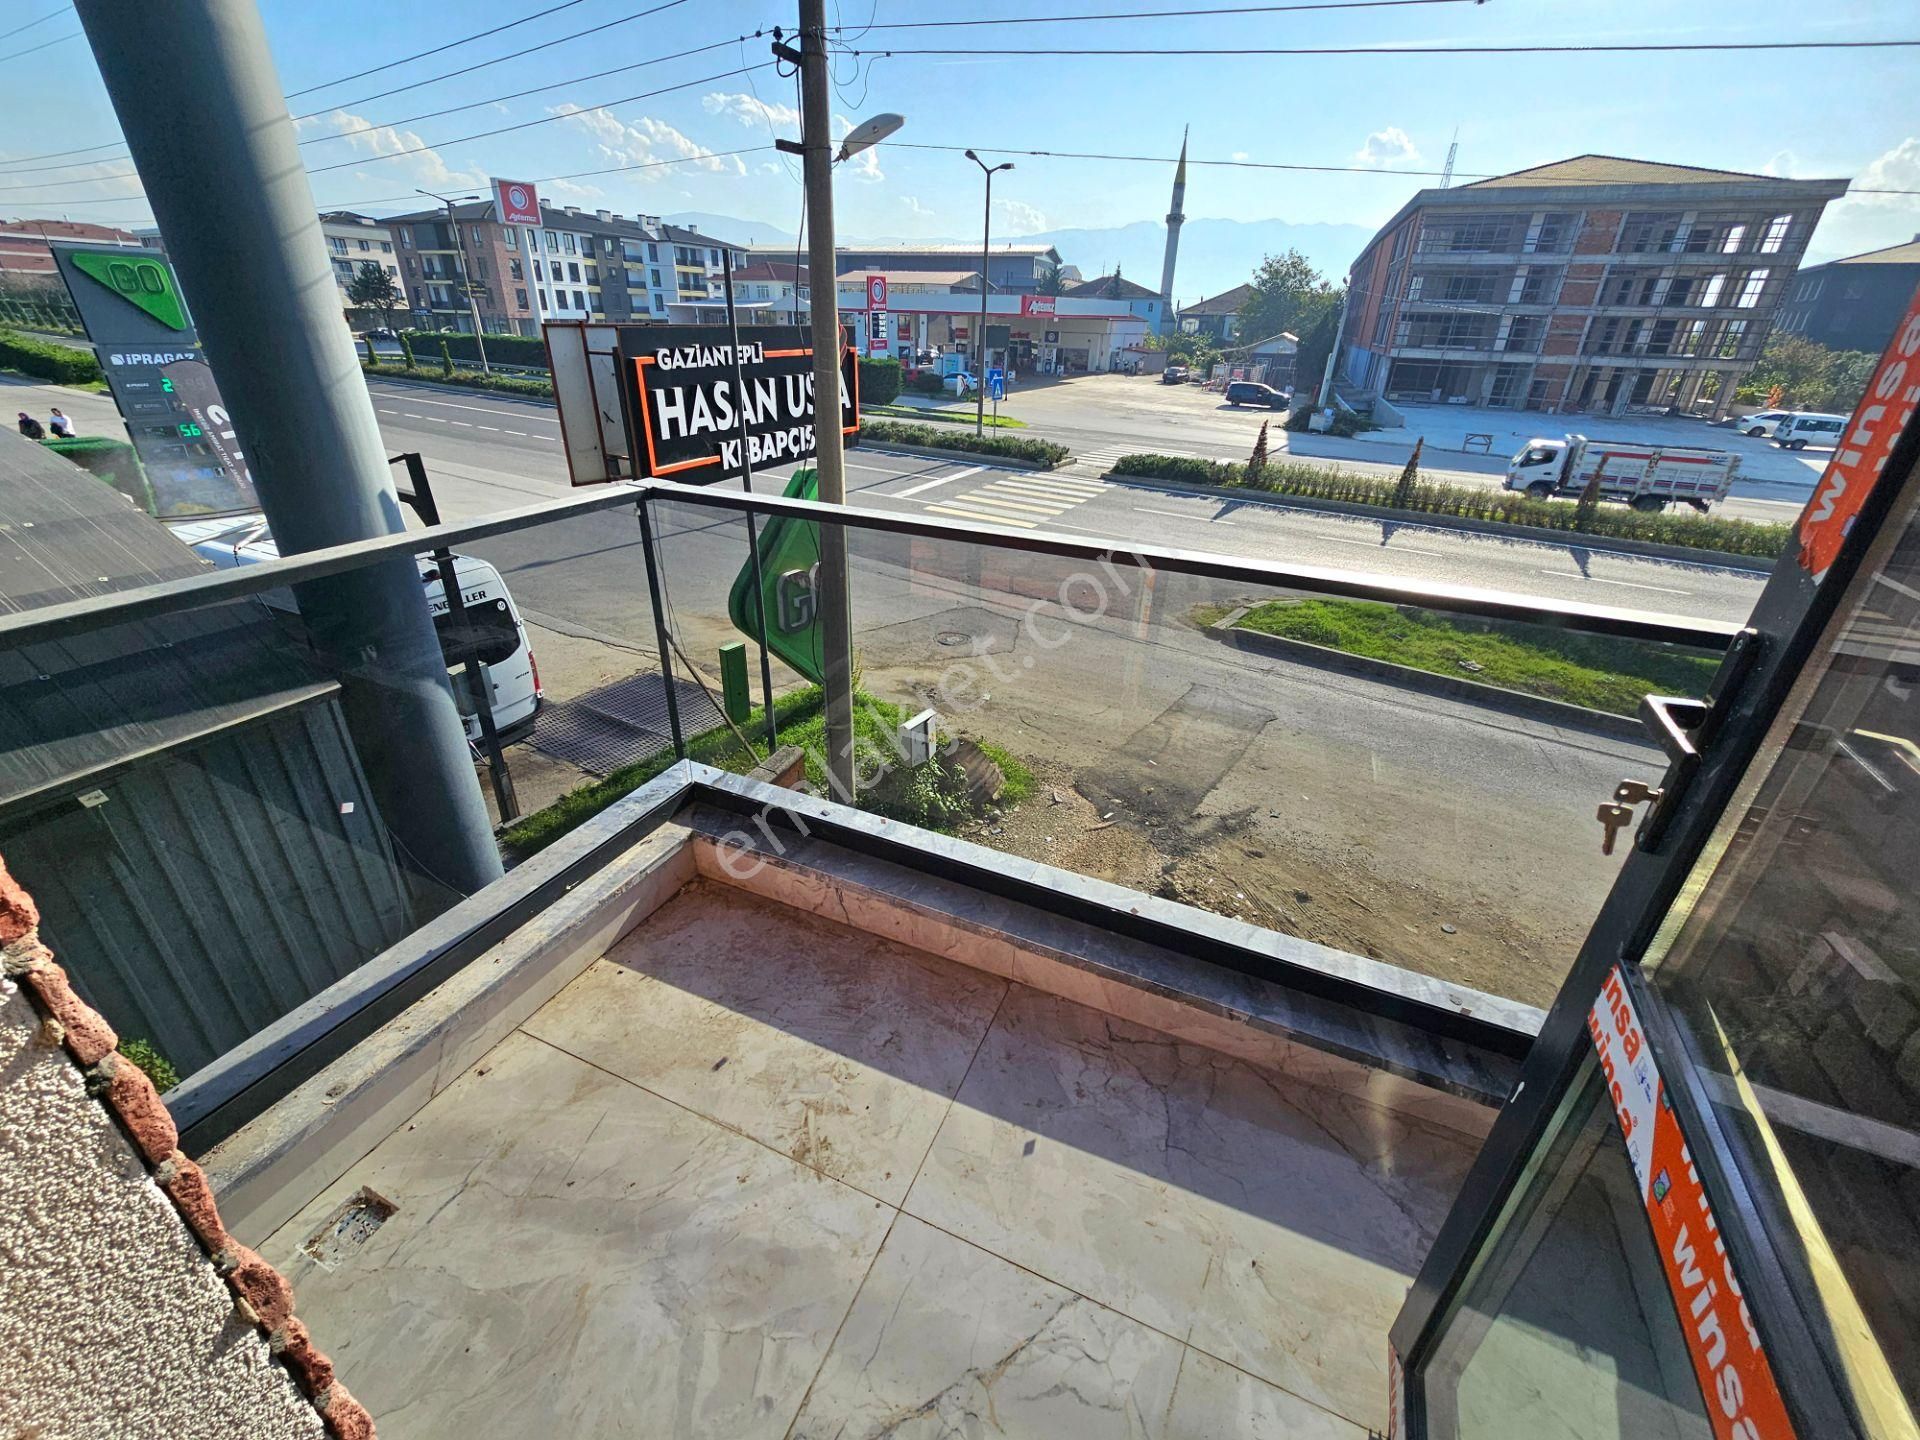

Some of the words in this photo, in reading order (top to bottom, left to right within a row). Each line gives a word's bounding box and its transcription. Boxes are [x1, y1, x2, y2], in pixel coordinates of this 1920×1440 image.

[108, 262, 165, 294] GO
[656, 341, 764, 371] GAZİANTEPLİ
[654, 377, 778, 441] HASAN
[783, 368, 852, 419] USA
[719, 423, 817, 471] KBAPÇIS
[1601, 963, 1642, 1066] insa
